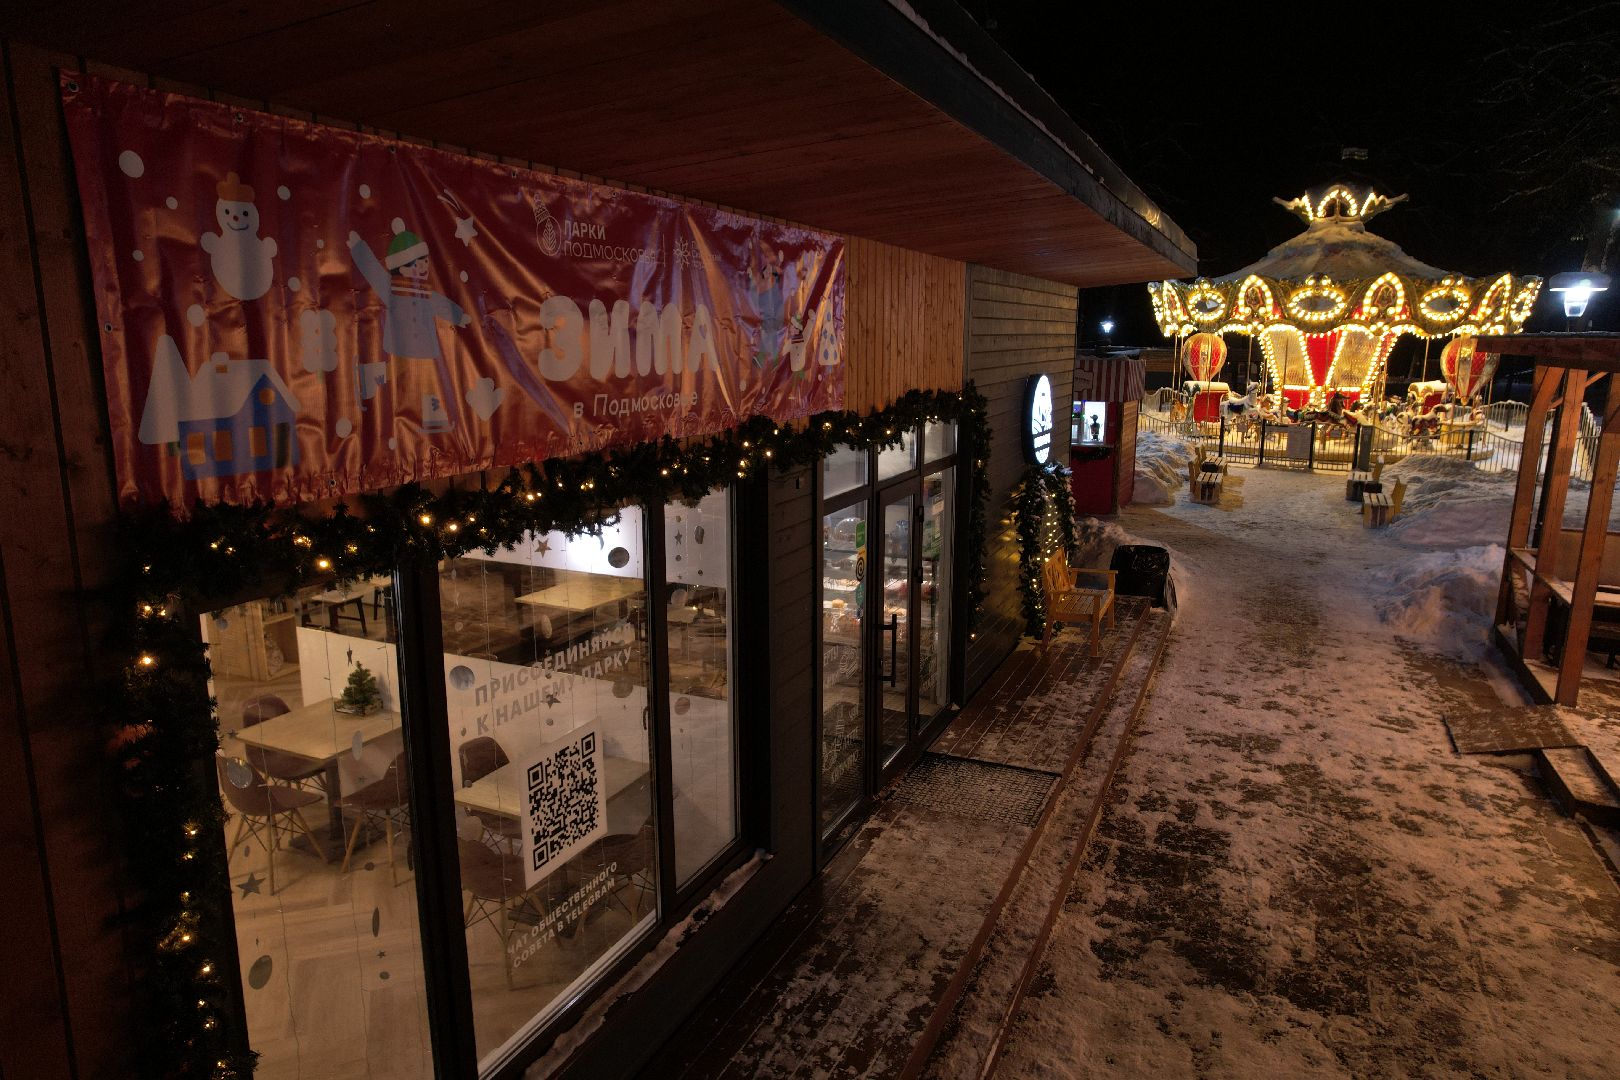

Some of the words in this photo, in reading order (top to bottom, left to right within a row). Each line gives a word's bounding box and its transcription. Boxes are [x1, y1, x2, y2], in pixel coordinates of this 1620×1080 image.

[564, 219, 607, 241] ПАРКИ
[564, 241, 656, 265] ПОДМОСКОВЬЯ
[537, 295, 718, 382] ЗИМА
[573, 401, 585, 418] в
[593, 391, 698, 418] Подмоскове
[476, 714, 489, 735] К
[495, 673, 576, 726] НАШЕМУ
[581, 646, 632, 685] ПАРКУ
[507, 933, 529, 954] ЧАТ
[531, 861, 617, 937] ОБЩЕСТВЕННОГО
[513, 929, 556, 968] СОВЕТА
[557, 920, 565, 933] В
[565, 878, 615, 925] TELEGRAM
